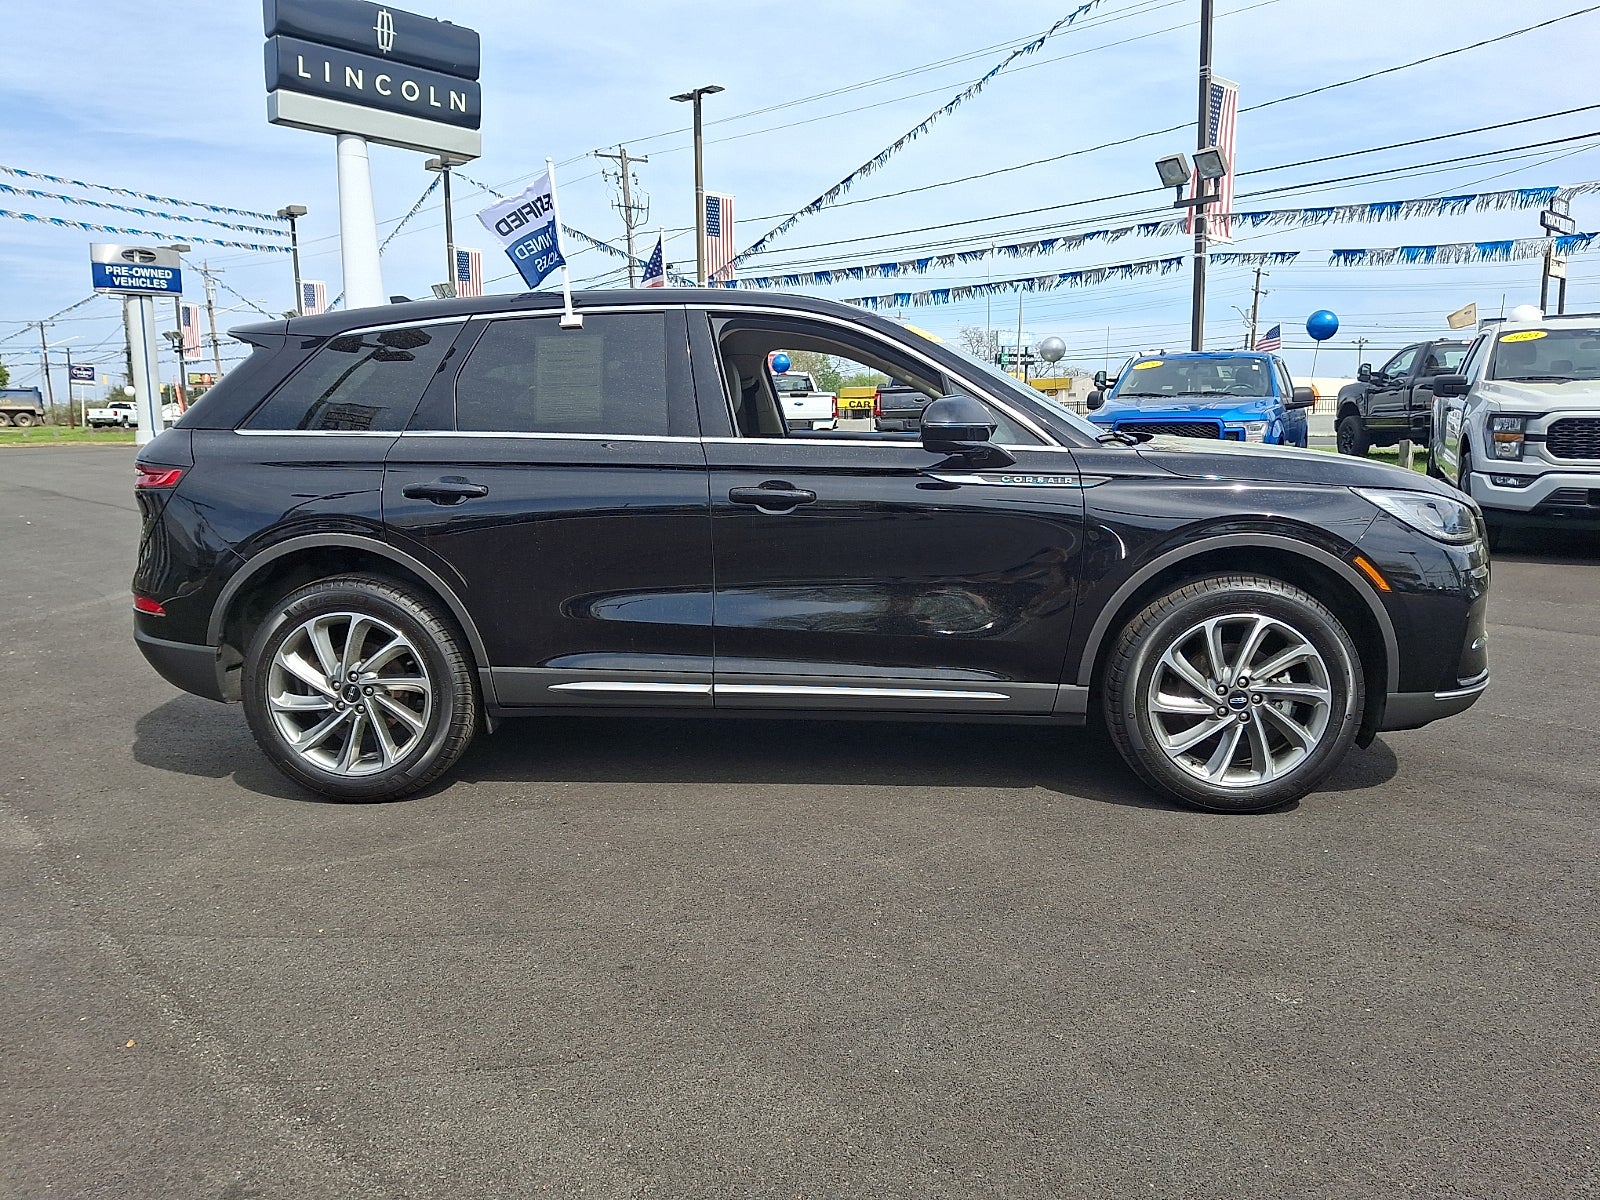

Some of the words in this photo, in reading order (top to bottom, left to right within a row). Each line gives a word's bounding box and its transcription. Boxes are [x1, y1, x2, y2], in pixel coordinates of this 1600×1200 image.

[297, 55, 466, 113] LINCOLN
[105, 265, 173, 280] PRE-OWNED
[112, 276, 168, 289] VEHICLES
[1002, 355, 1034, 363] enteprise
[848, 400, 872, 409] CAR
[1001, 475, 1073, 484] CORSAIR
